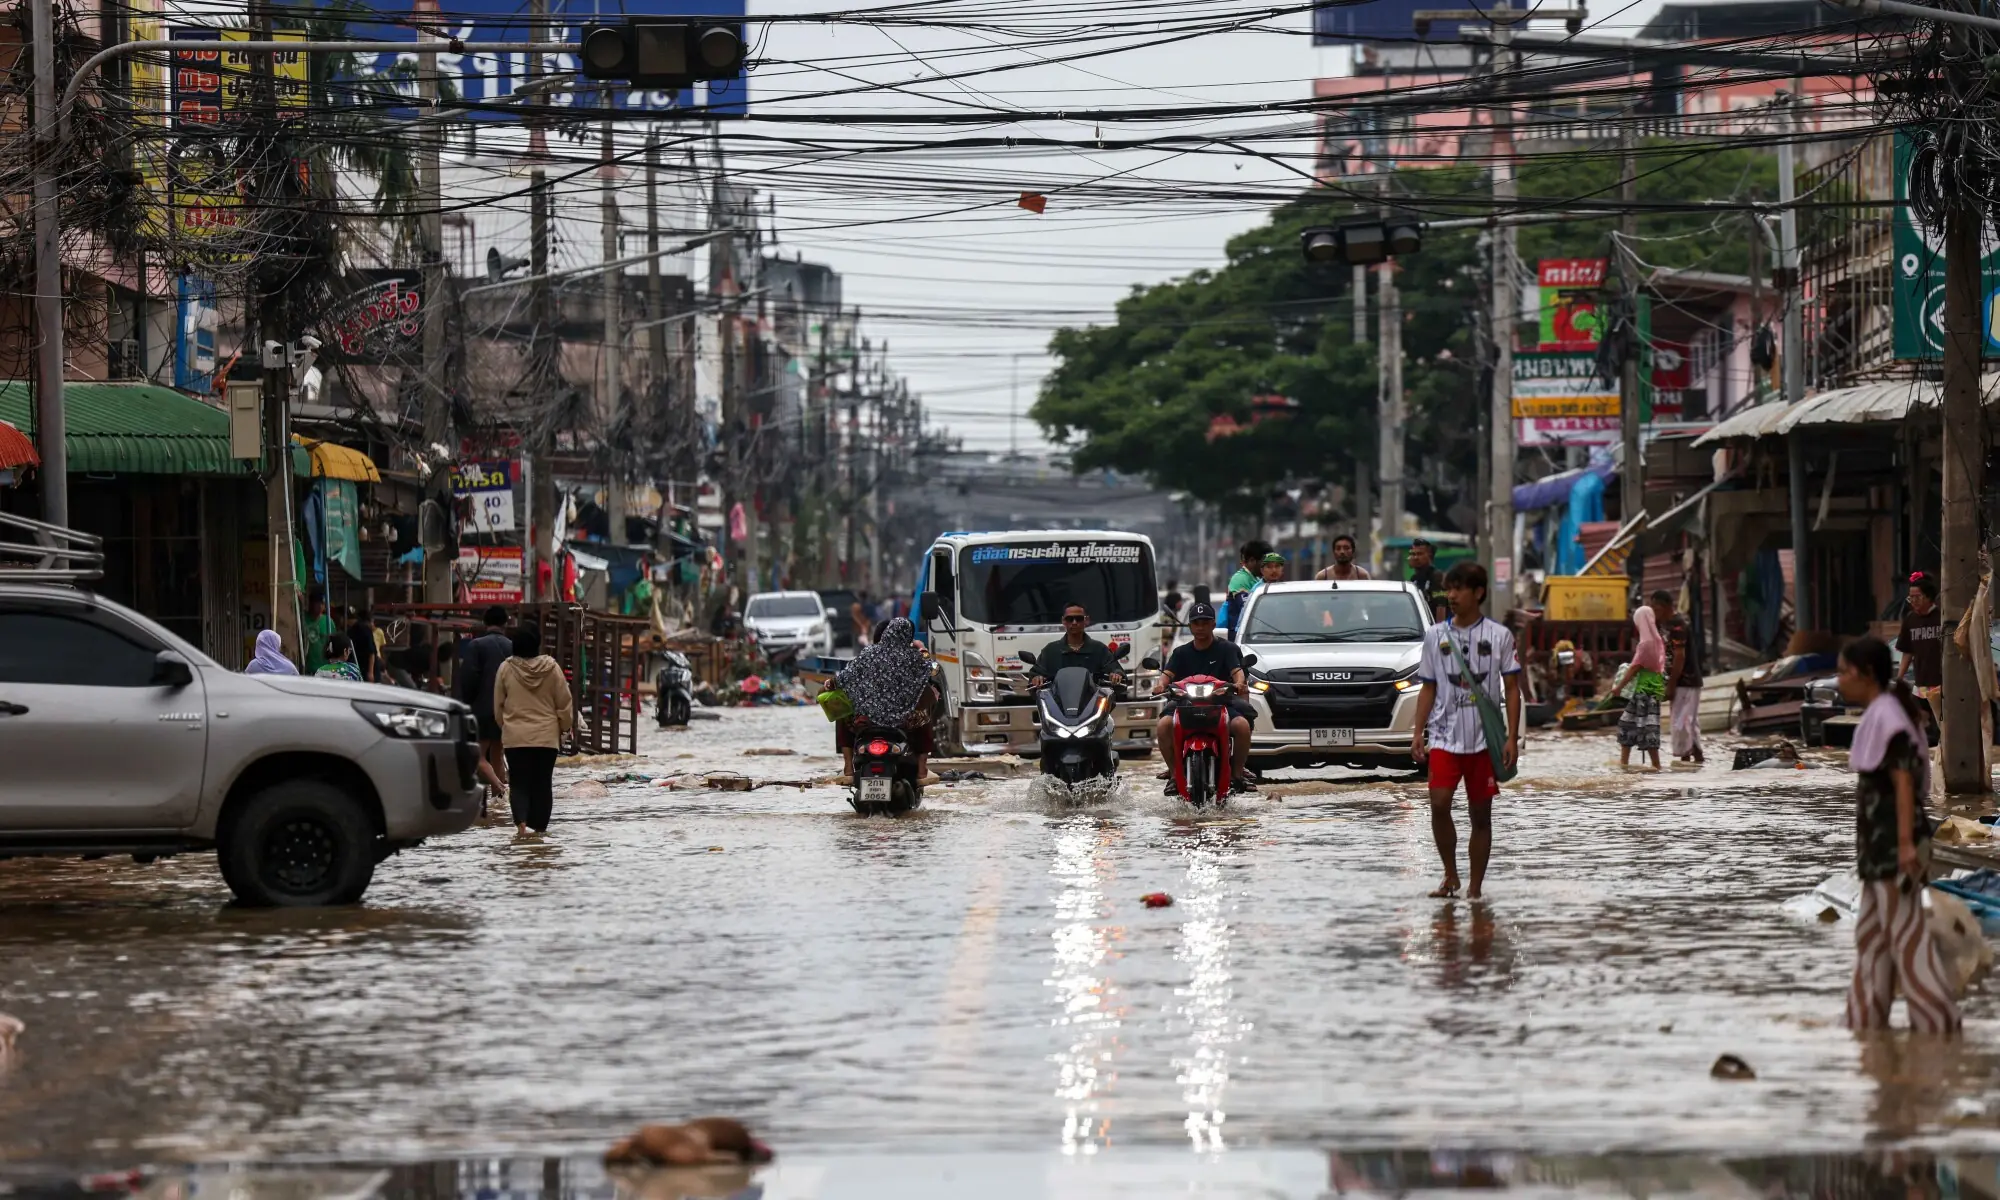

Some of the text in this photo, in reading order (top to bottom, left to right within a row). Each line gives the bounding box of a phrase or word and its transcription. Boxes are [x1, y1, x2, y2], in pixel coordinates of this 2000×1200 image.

[1545, 262, 1602, 283] mini
[1067, 547, 1079, 558] &
[1197, 606, 1204, 614] C
[1312, 672, 1351, 680] ISUZU
[1331, 729, 1352, 738] 8761
